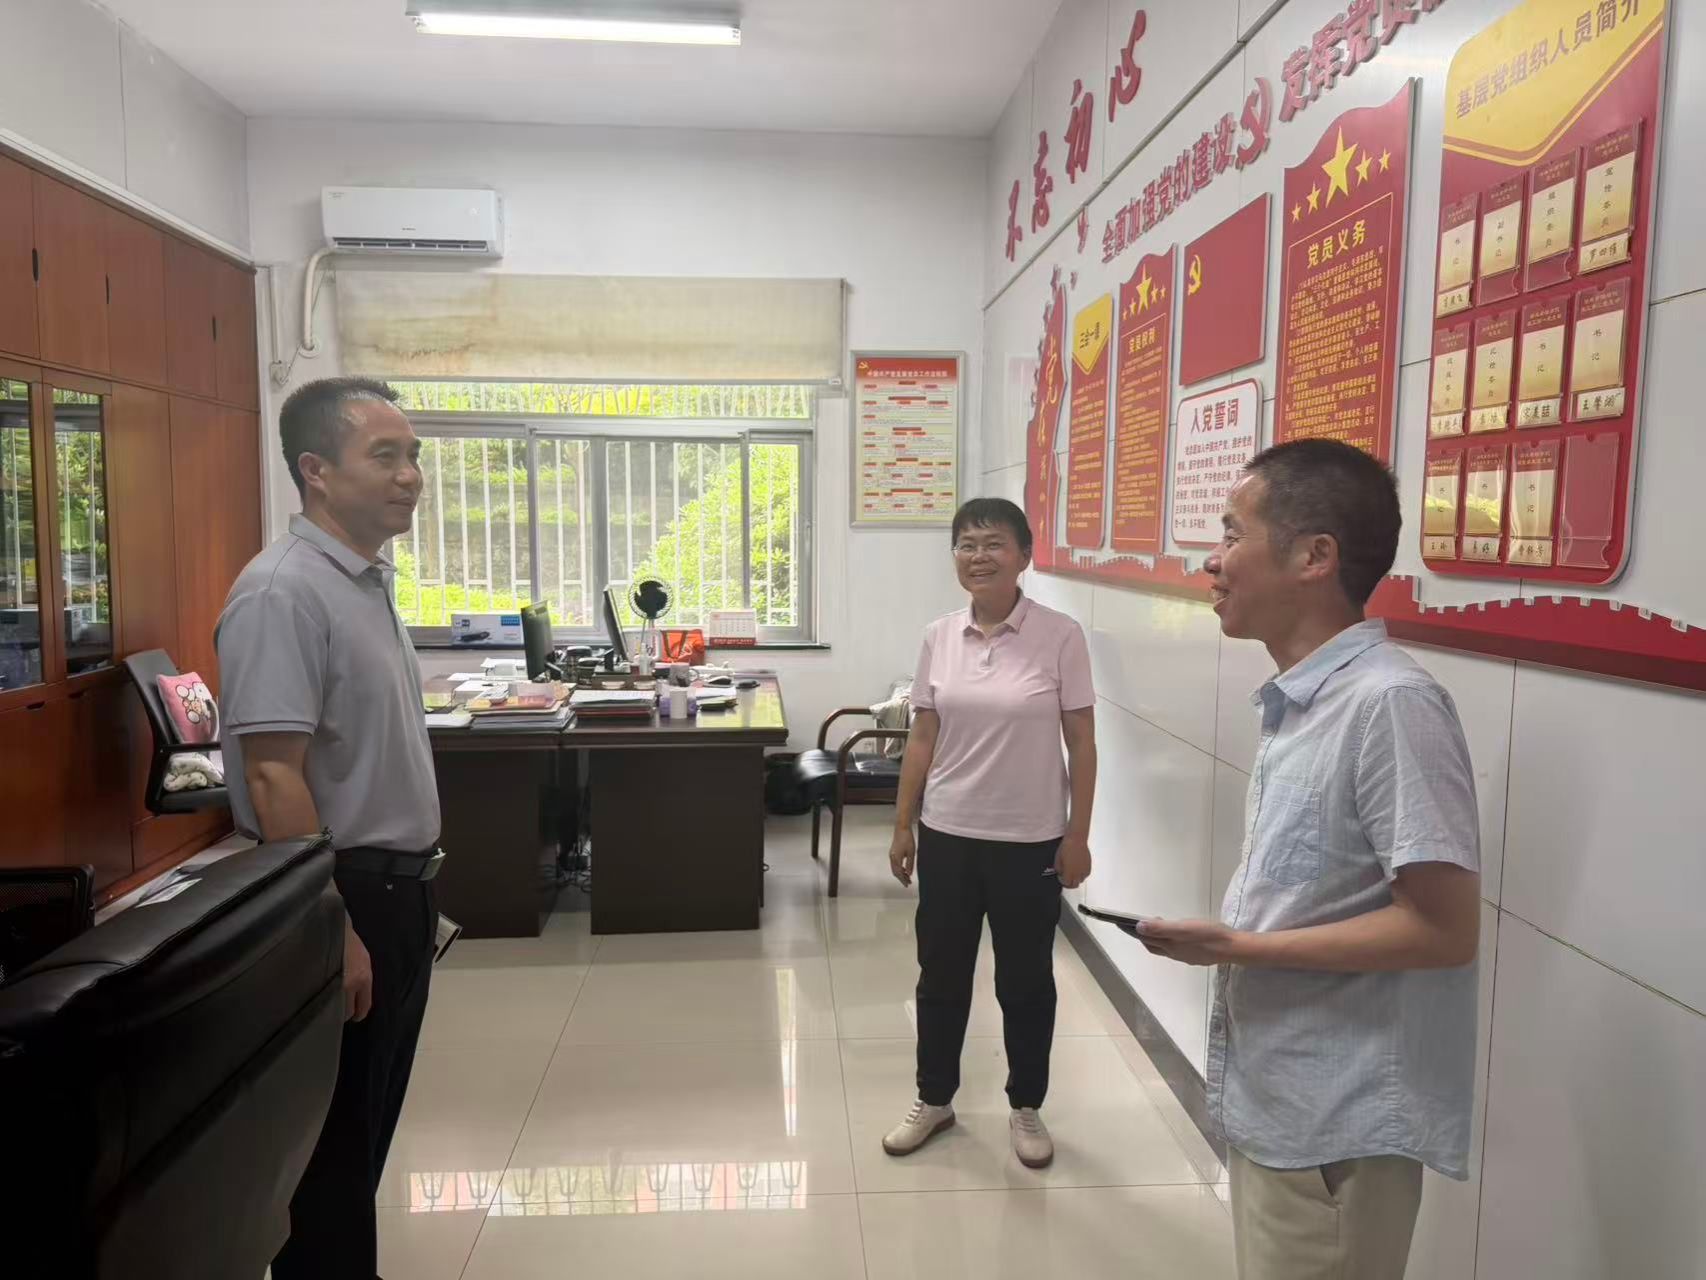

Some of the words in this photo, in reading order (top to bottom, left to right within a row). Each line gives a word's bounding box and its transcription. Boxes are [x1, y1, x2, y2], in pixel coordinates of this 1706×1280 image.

[1456, 0, 1640, 119] 基层党组织人员简介
[1101, 112, 1237, 264] 全面加强党的建设
[1307, 219, 1366, 269] 党员义务
